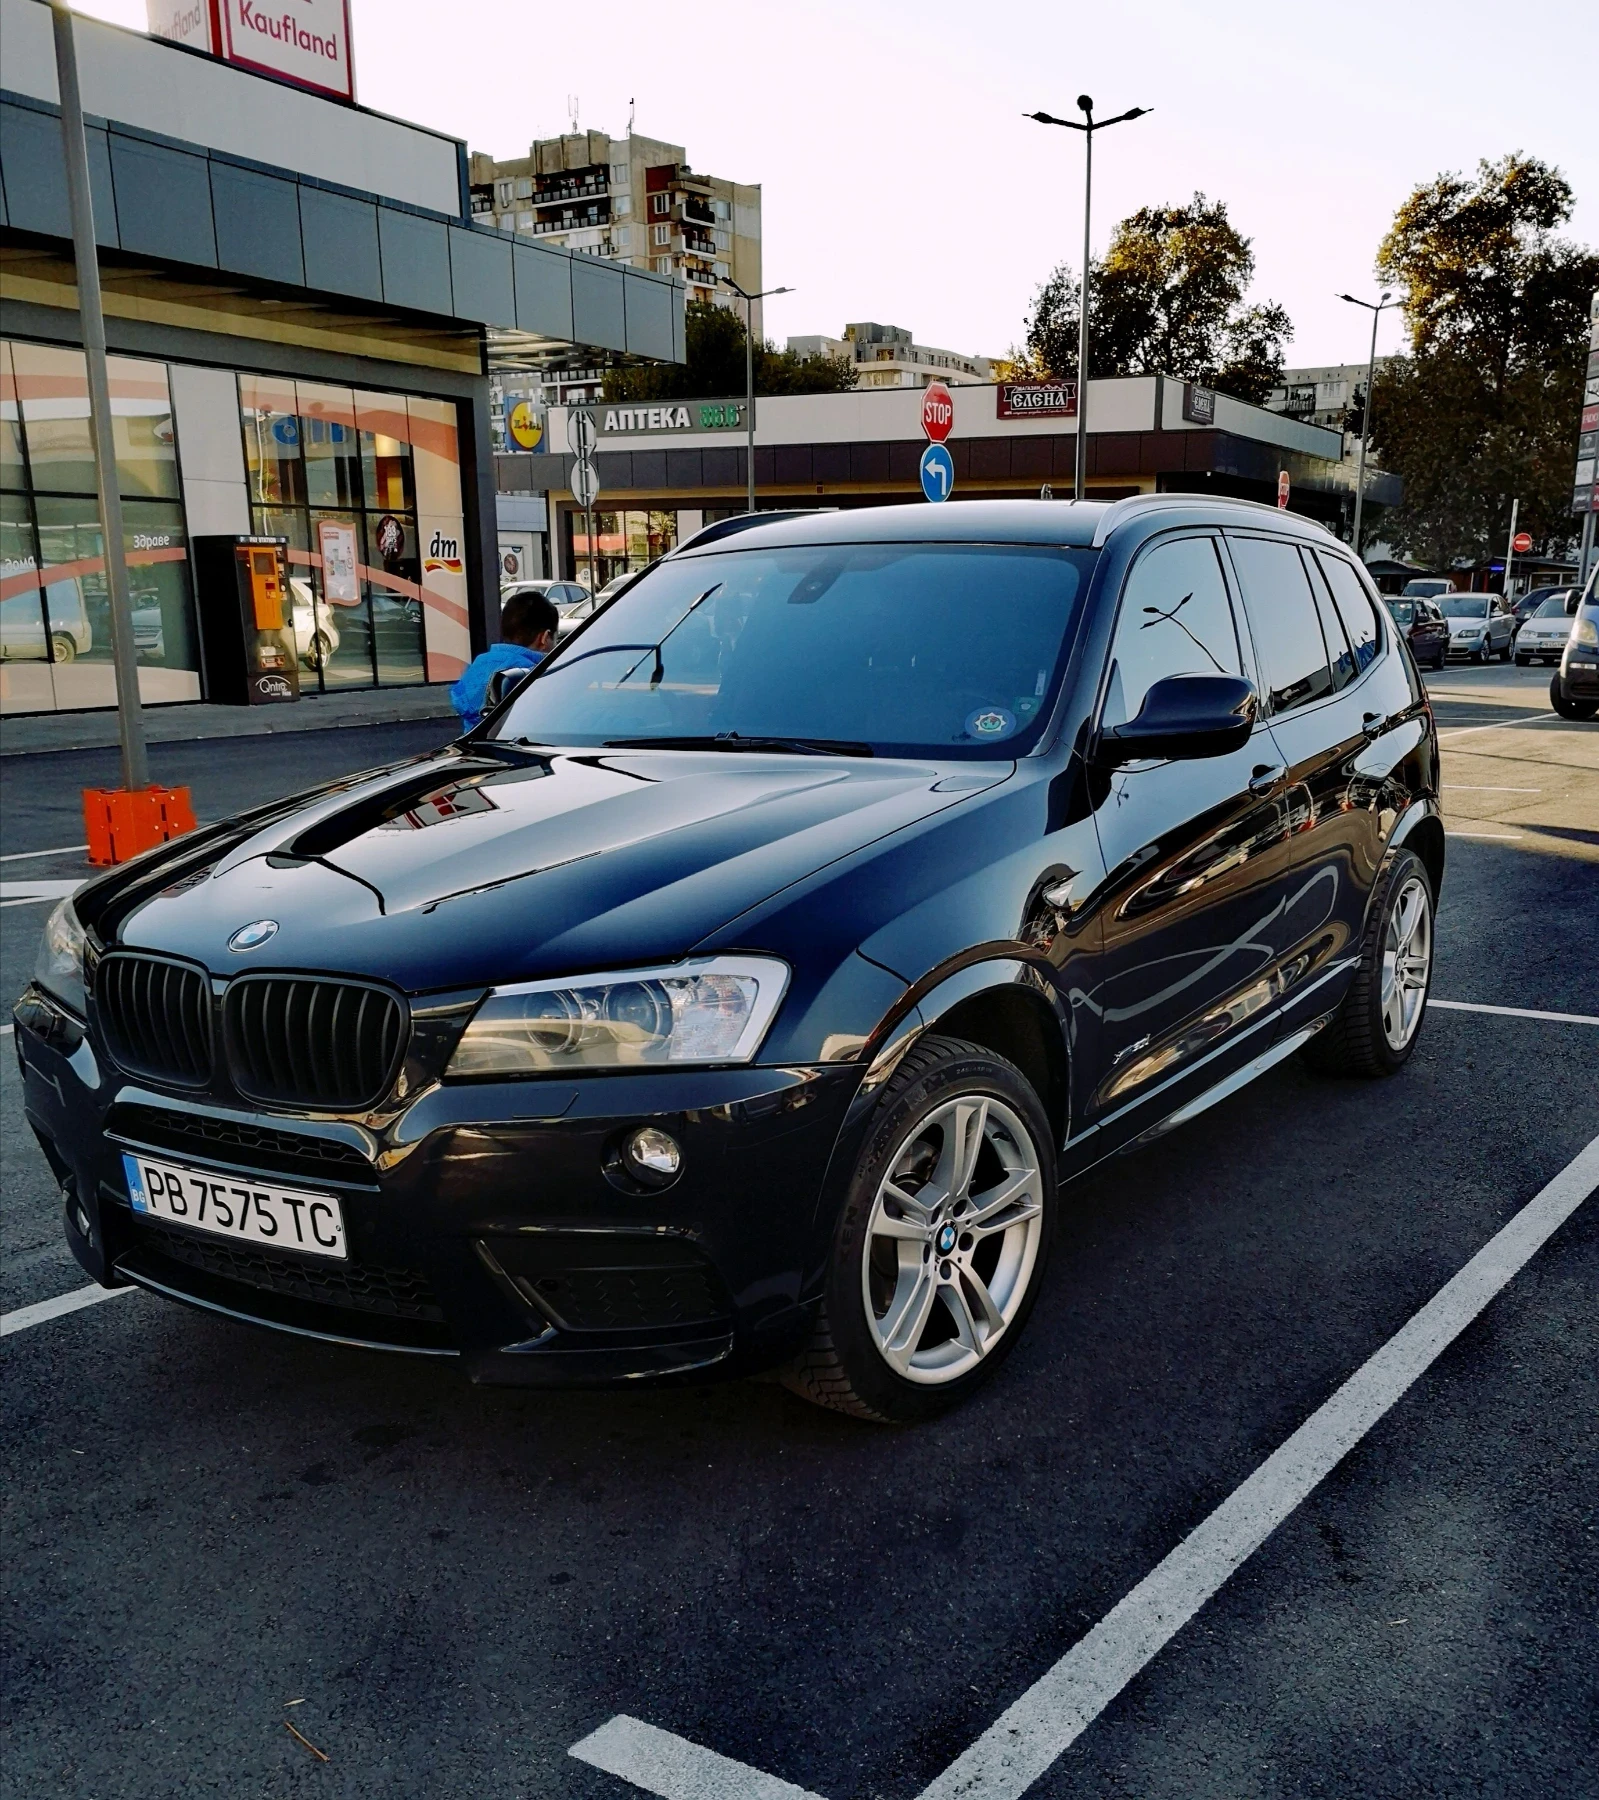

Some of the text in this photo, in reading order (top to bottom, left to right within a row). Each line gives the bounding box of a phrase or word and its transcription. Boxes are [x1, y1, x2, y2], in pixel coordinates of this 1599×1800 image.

[240, 0, 337, 61] Kaufland
[1013, 392, 1066, 408] ЕЛЕНА
[604, 407, 691, 431] АПТЕКА
[925, 401, 952, 425] STOP
[134, 534, 170, 550] Здраве
[430, 531, 457, 558] dm
[133, 1189, 146, 1203] BG
[144, 1166, 337, 1248] PB 7575 TC
